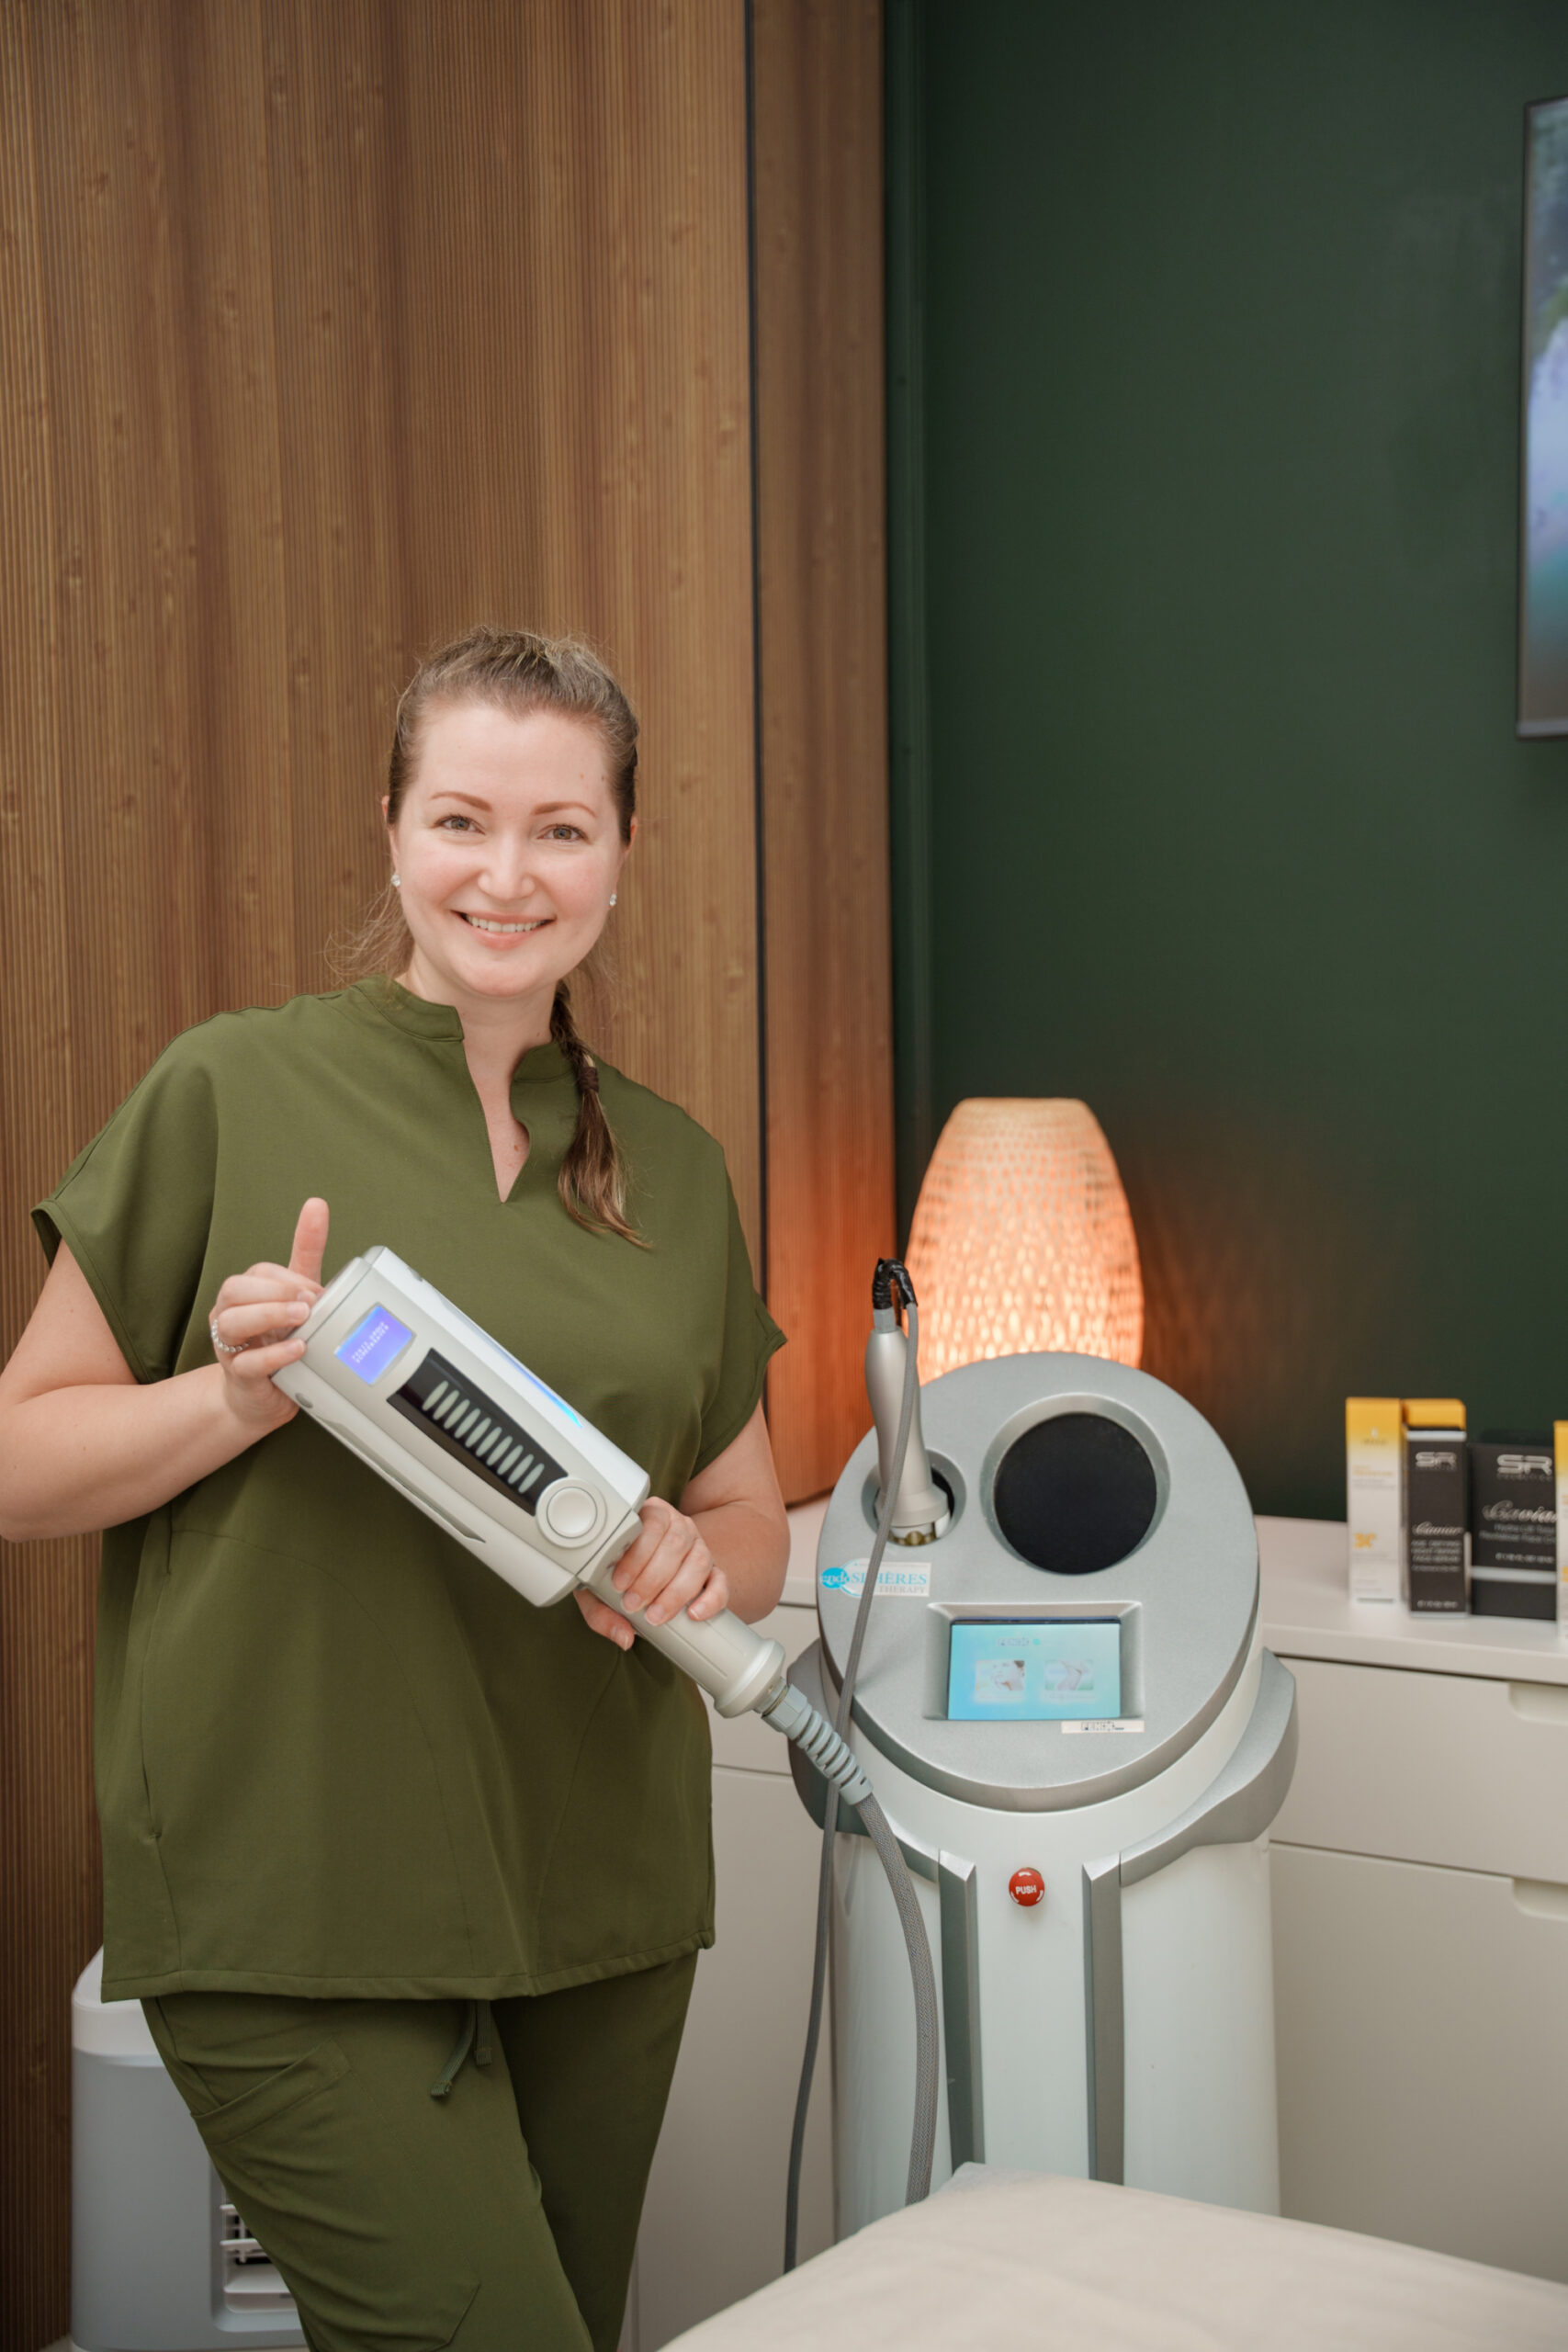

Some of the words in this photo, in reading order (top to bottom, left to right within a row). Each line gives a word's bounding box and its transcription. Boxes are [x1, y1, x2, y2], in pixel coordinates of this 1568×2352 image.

[1496, 1454, 1552, 1476] SR
[1482, 1499, 1557, 1523] Cavia
[879, 1585, 926, 1594] THERAPY
[1015, 1884, 1037, 1895] PUSH
